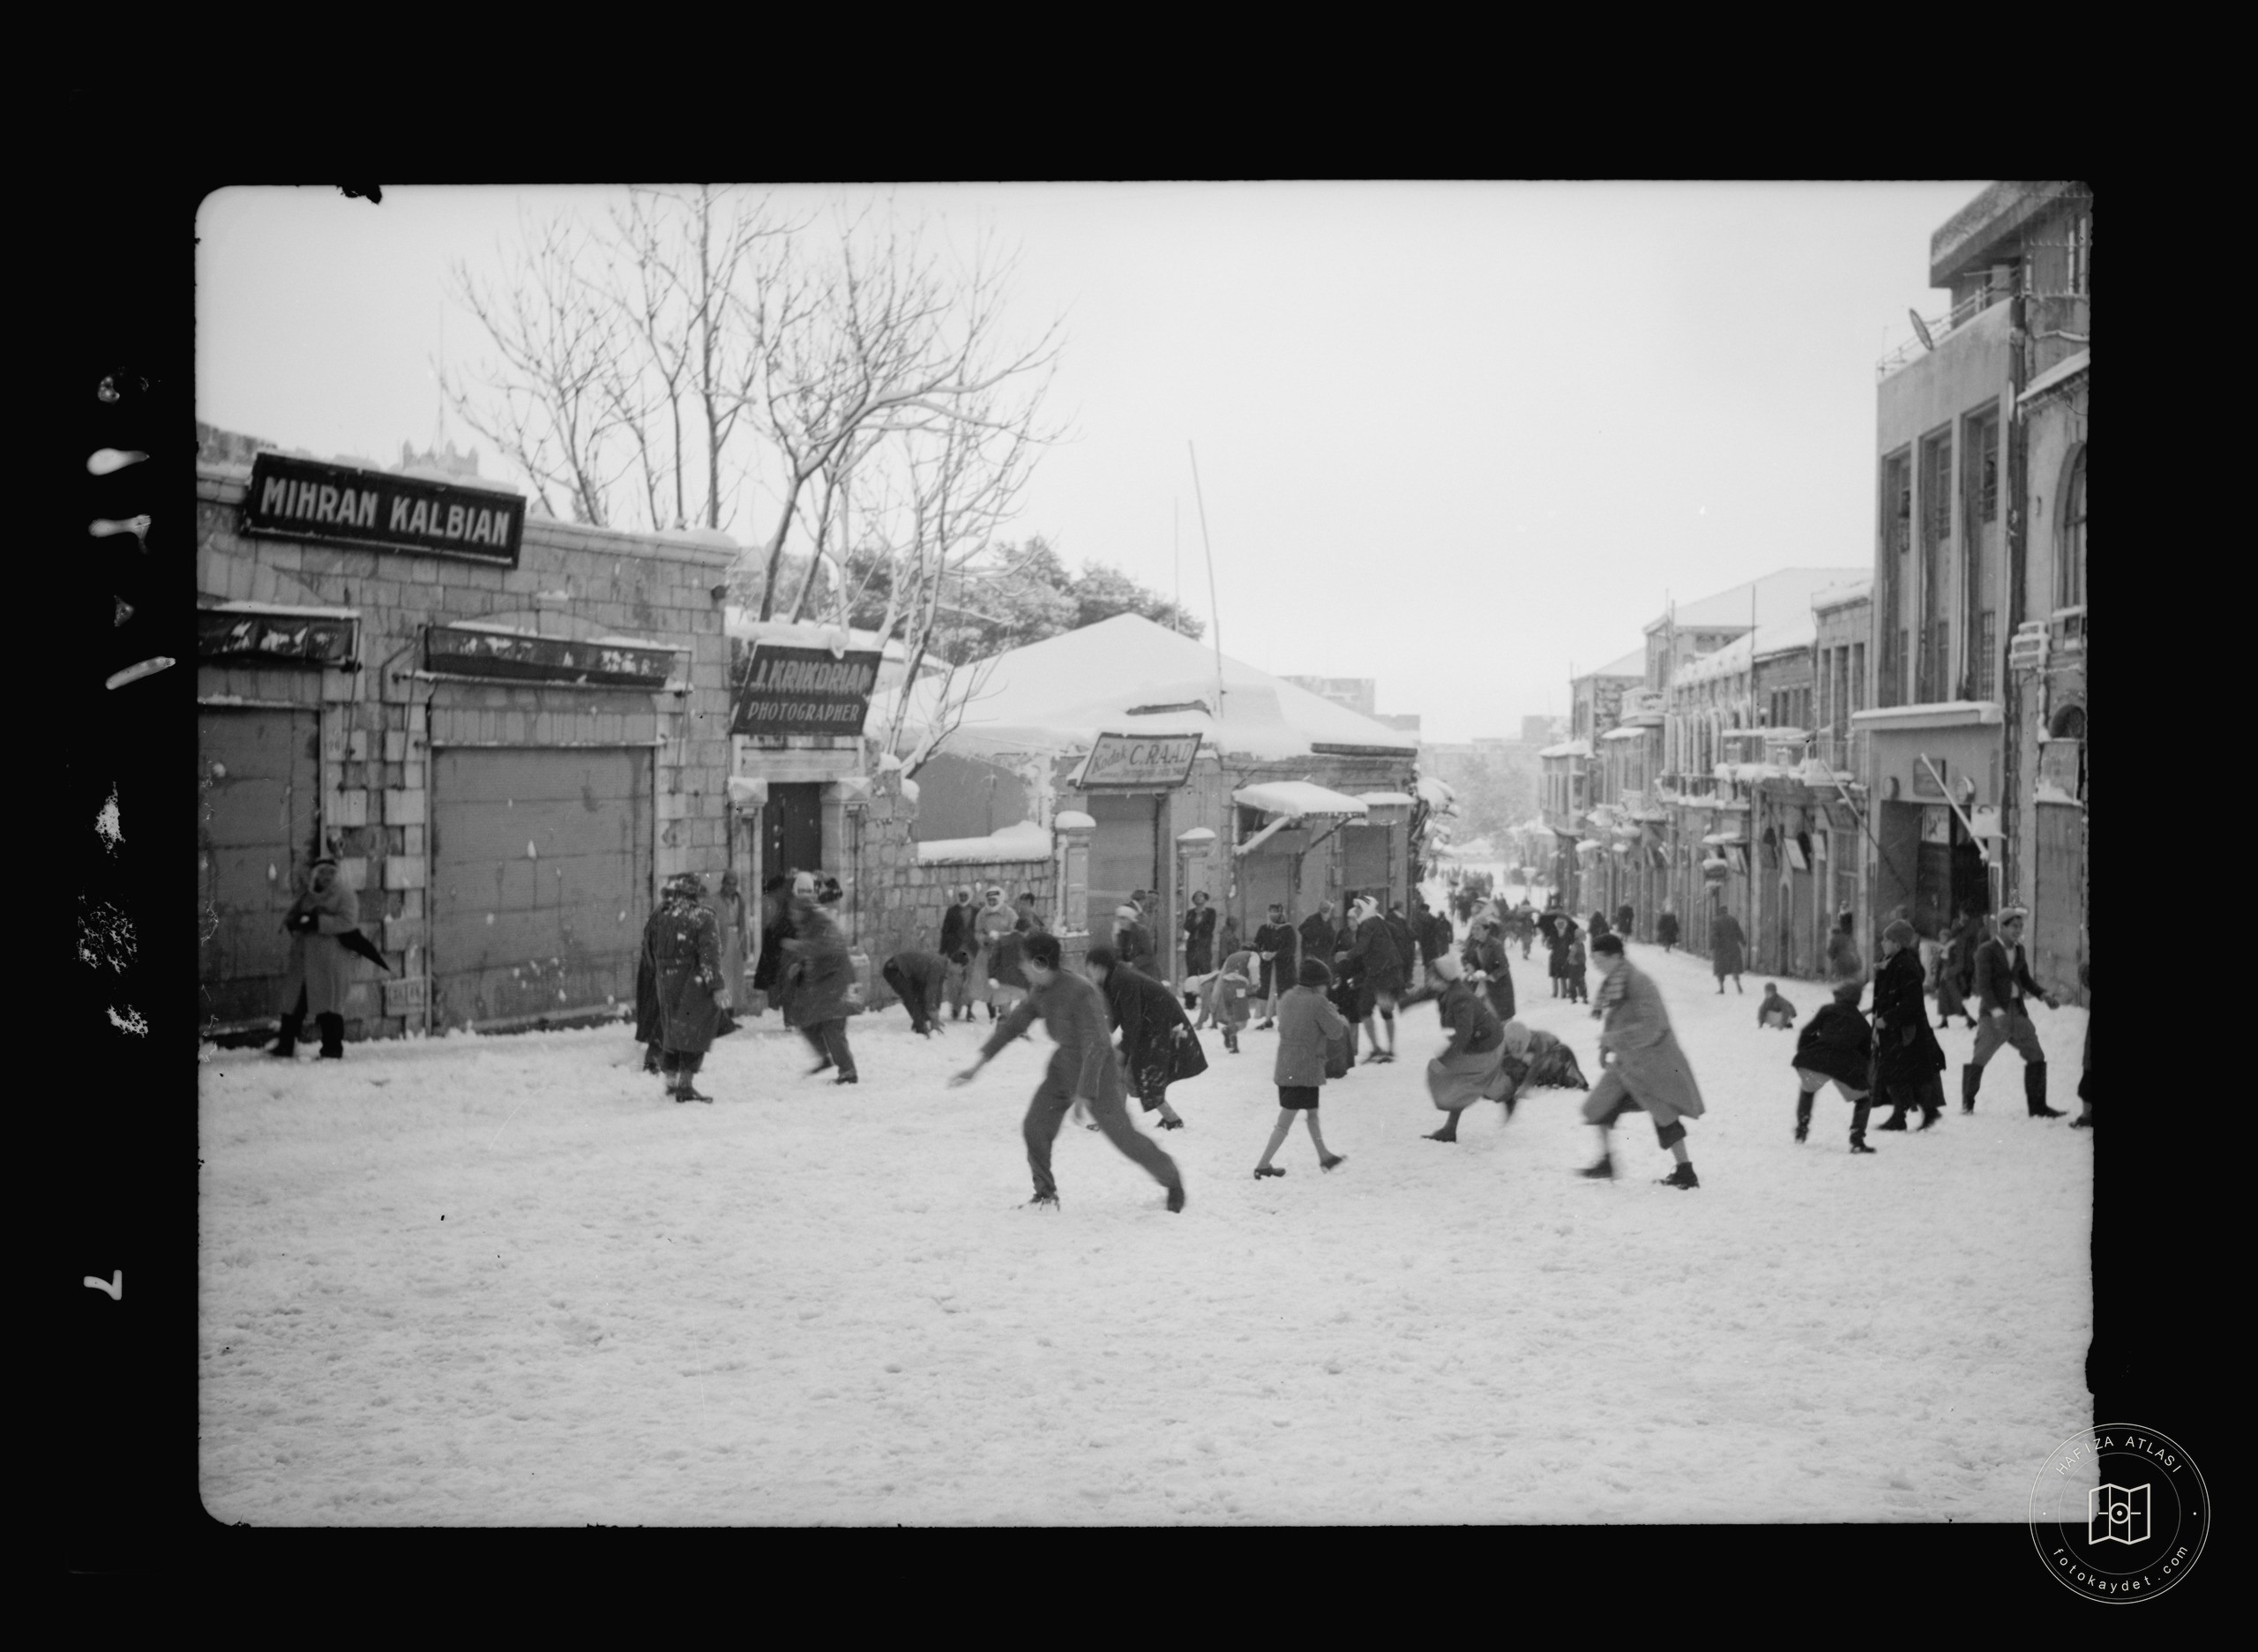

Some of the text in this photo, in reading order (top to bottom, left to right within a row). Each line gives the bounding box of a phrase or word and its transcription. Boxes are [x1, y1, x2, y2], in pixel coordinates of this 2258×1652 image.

[261, 476, 510, 547] MIHRAN KALBIAN
[747, 701, 860, 721] PHOTOGRAPHER
[1091, 744, 1127, 774] Kodak
